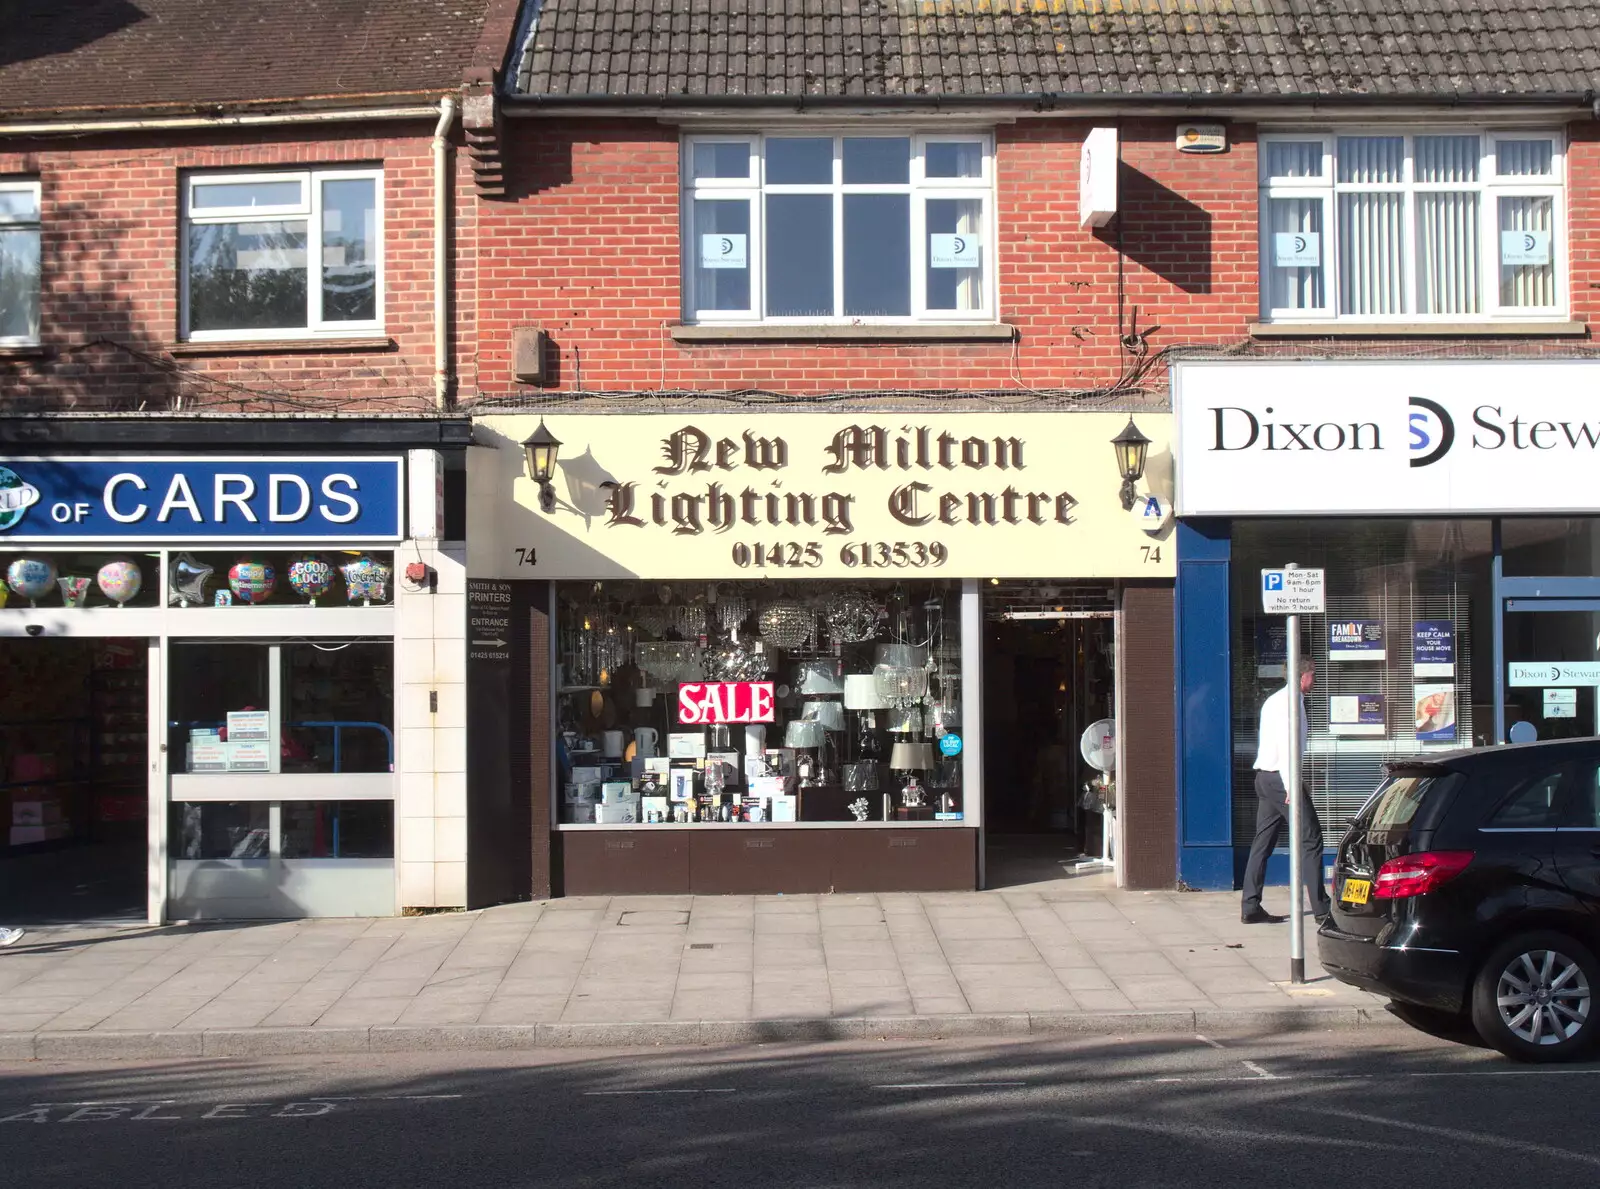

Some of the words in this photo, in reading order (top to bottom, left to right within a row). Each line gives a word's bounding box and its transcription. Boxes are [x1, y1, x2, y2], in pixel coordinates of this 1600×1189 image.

[1207, 406, 1384, 451] Dixon
[1472, 405, 1600, 450] Stew
[652, 424, 788, 476] New
[822, 424, 1027, 476] Milton
[51, 502, 91, 523] OF
[103, 472, 361, 524] CARDS
[599, 478, 855, 536] Lighting
[888, 480, 1079, 526] Centre
[515, 548, 537, 566] 74
[732, 541, 823, 568] 01425
[840, 541, 948, 568] 613539
[1140, 546, 1162, 564] 74
[238, 569, 264, 579] Happy
[296, 562, 328, 574] GOOD
[296, 573, 328, 584] LUCK!
[1269, 575, 1280, 590] P
[469, 592, 512, 603] PRINTERS
[471, 617, 509, 627] ENTRANCE
[1332, 622, 1363, 636] FAMILY
[1514, 668, 1547, 678] Dixon
[679, 683, 775, 723] SALE
